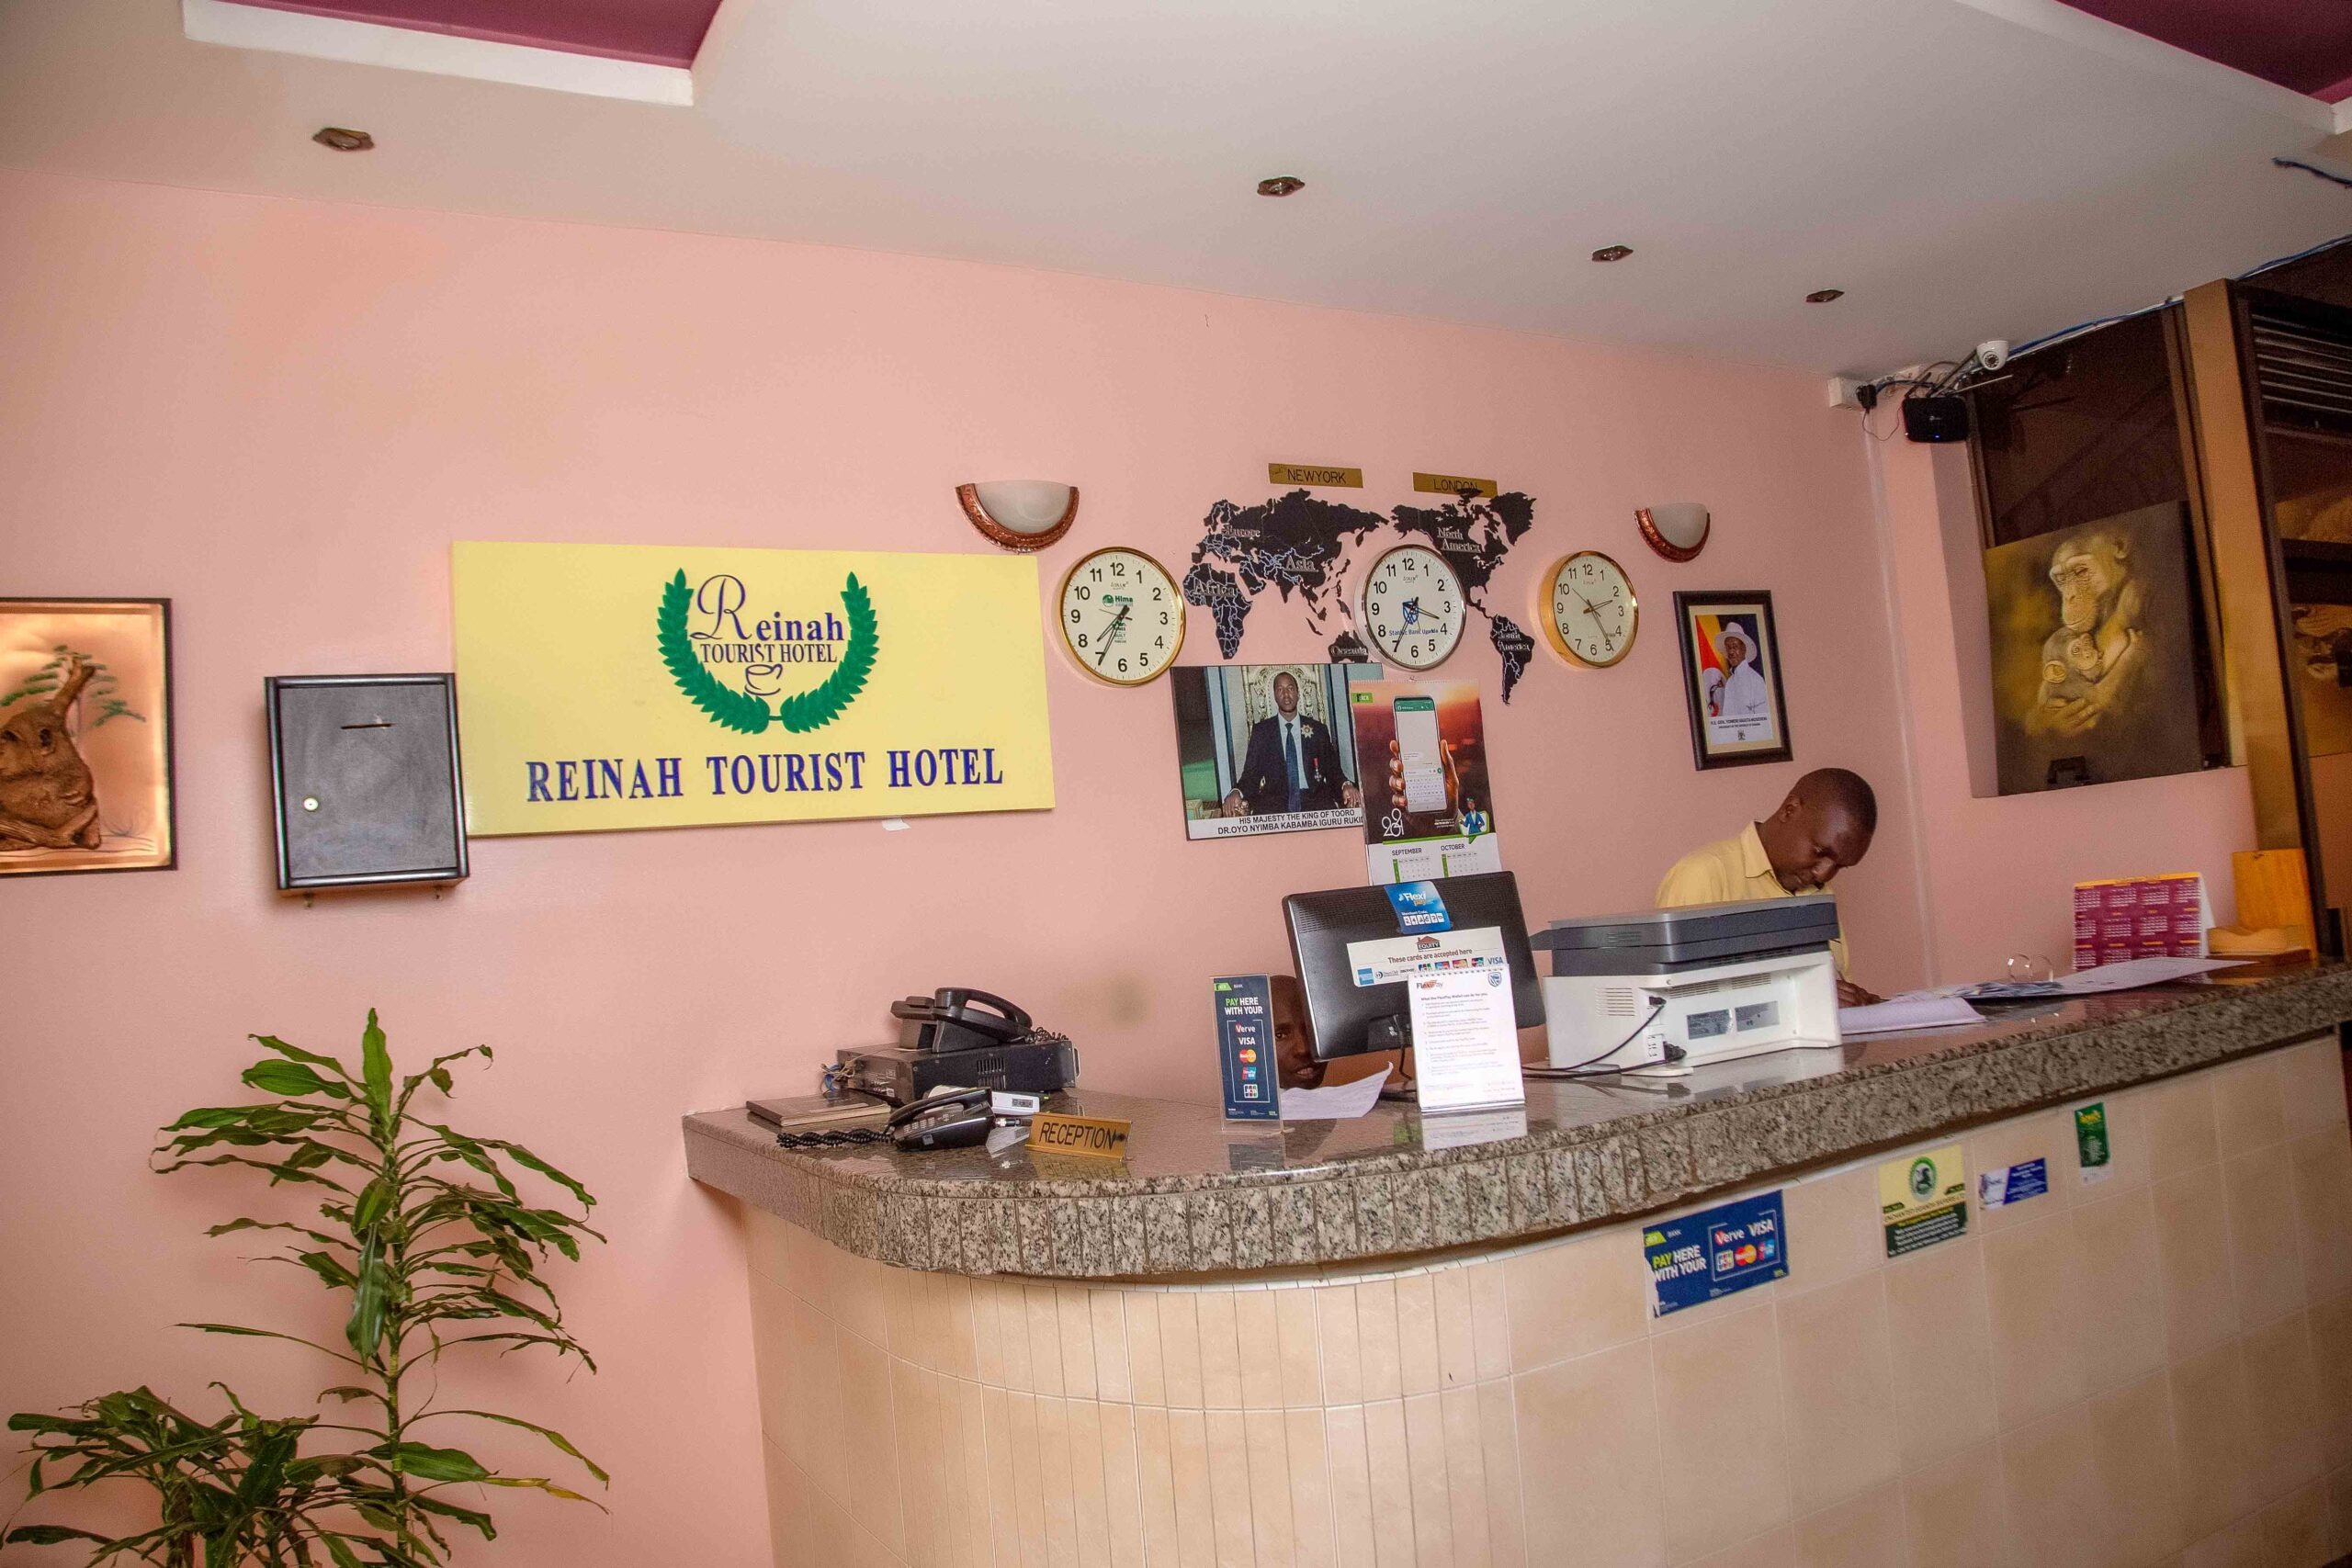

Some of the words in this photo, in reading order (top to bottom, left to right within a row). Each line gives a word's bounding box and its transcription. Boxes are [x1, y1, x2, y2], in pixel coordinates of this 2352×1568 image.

[1287, 468, 1347, 484] NEWYORK
[1433, 479, 1477, 491] LONDON
[1437, 527, 1463, 539] North
[1442, 538, 1481, 552] America
[1110, 562, 1125, 576] 12
[1286, 555, 1316, 571] Asia
[1402, 558, 1415, 570] 12
[1090, 569, 1102, 582] 11
[1136, 570, 1142, 583] 1
[1385, 564, 1396, 577] 11
[1423, 564, 1430, 577] 1
[1567, 568, 1577, 580] 11
[1582, 564, 1593, 576] 12
[1600, 570, 1605, 581] 1
[1194, 581, 1236, 596] Africa
[1374, 581, 1387, 594] 10
[1437, 579, 1445, 591] 2
[1558, 583, 1570, 595] 10
[1612, 585, 1620, 597] 2
[1074, 586, 1091, 600] 10
[1152, 588, 1161, 601] 2
[689, 574, 844, 641] Reinah
[1372, 603, 1380, 615] 9
[1443, 601, 1451, 613] 3
[1556, 602, 1564, 615] 9
[1618, 605, 1624, 617] 3
[1071, 609, 1080, 623] 9
[1159, 612, 1169, 625] 3
[1378, 625, 1386, 637] 8
[1440, 623, 1448, 635] 4
[1562, 623, 1570, 635] 8
[1615, 625, 1622, 637] 4
[1078, 634, 1088, 648] 8
[1155, 636, 1164, 649] 4
[1392, 640, 1400, 652] 7
[1428, 639, 1436, 651] 5
[1575, 638, 1582, 650] 7
[1605, 639, 1612, 651] 5
[700, 643, 775, 663] TOURIST
[781, 643, 838, 663] HOTEL
[1410, 645, 1419, 658] 6
[1589, 644, 1598, 656] 6
[1095, 652, 1104, 665] 7
[1139, 653, 1148, 667] 5
[1118, 659, 1127, 672] 6
[526, 757, 684, 803] REINAH
[706, 751, 865, 795] TOURIST
[888, 748, 1003, 787] HOTEL
[1252, 814, 1285, 824] MAJESTY
[1331, 809, 1355, 818] TOORO
[1217, 825, 1249, 835] DR.OYO
[1250, 822, 1280, 832] NYIMBA
[1281, 819, 1317, 829] KABAMBA
[1319, 818, 1342, 827] IGURU
[1391, 848, 1422, 856] SEPTEMBER
[1418, 942, 1440, 950] EQUITY
[1388, 956, 1406, 964] These
[1407, 954, 1423, 963] cards
[1434, 950, 1458, 959] accepted
[1487, 956, 1504, 964] VISA
[1226, 998, 1239, 1006] PAY
[1239, 997, 1259, 1006] HERE
[1225, 1007, 1243, 1015] WITH
[1243, 1006, 1263, 1015] YOUR
[1235, 1023, 1256, 1032] Verve
[1238, 1037, 1256, 1045] VISA
[1039, 1122, 1117, 1150] RECEPTION
[1714, 1229, 1745, 1246] Verve
[1747, 1219, 1775, 1237] VISA
[1652, 1253, 1673, 1269] PAY
[1672, 1245, 1701, 1263] HERE
[1655, 1264, 1679, 1282] WITH
[1679, 1258, 1707, 1275] YOUR
